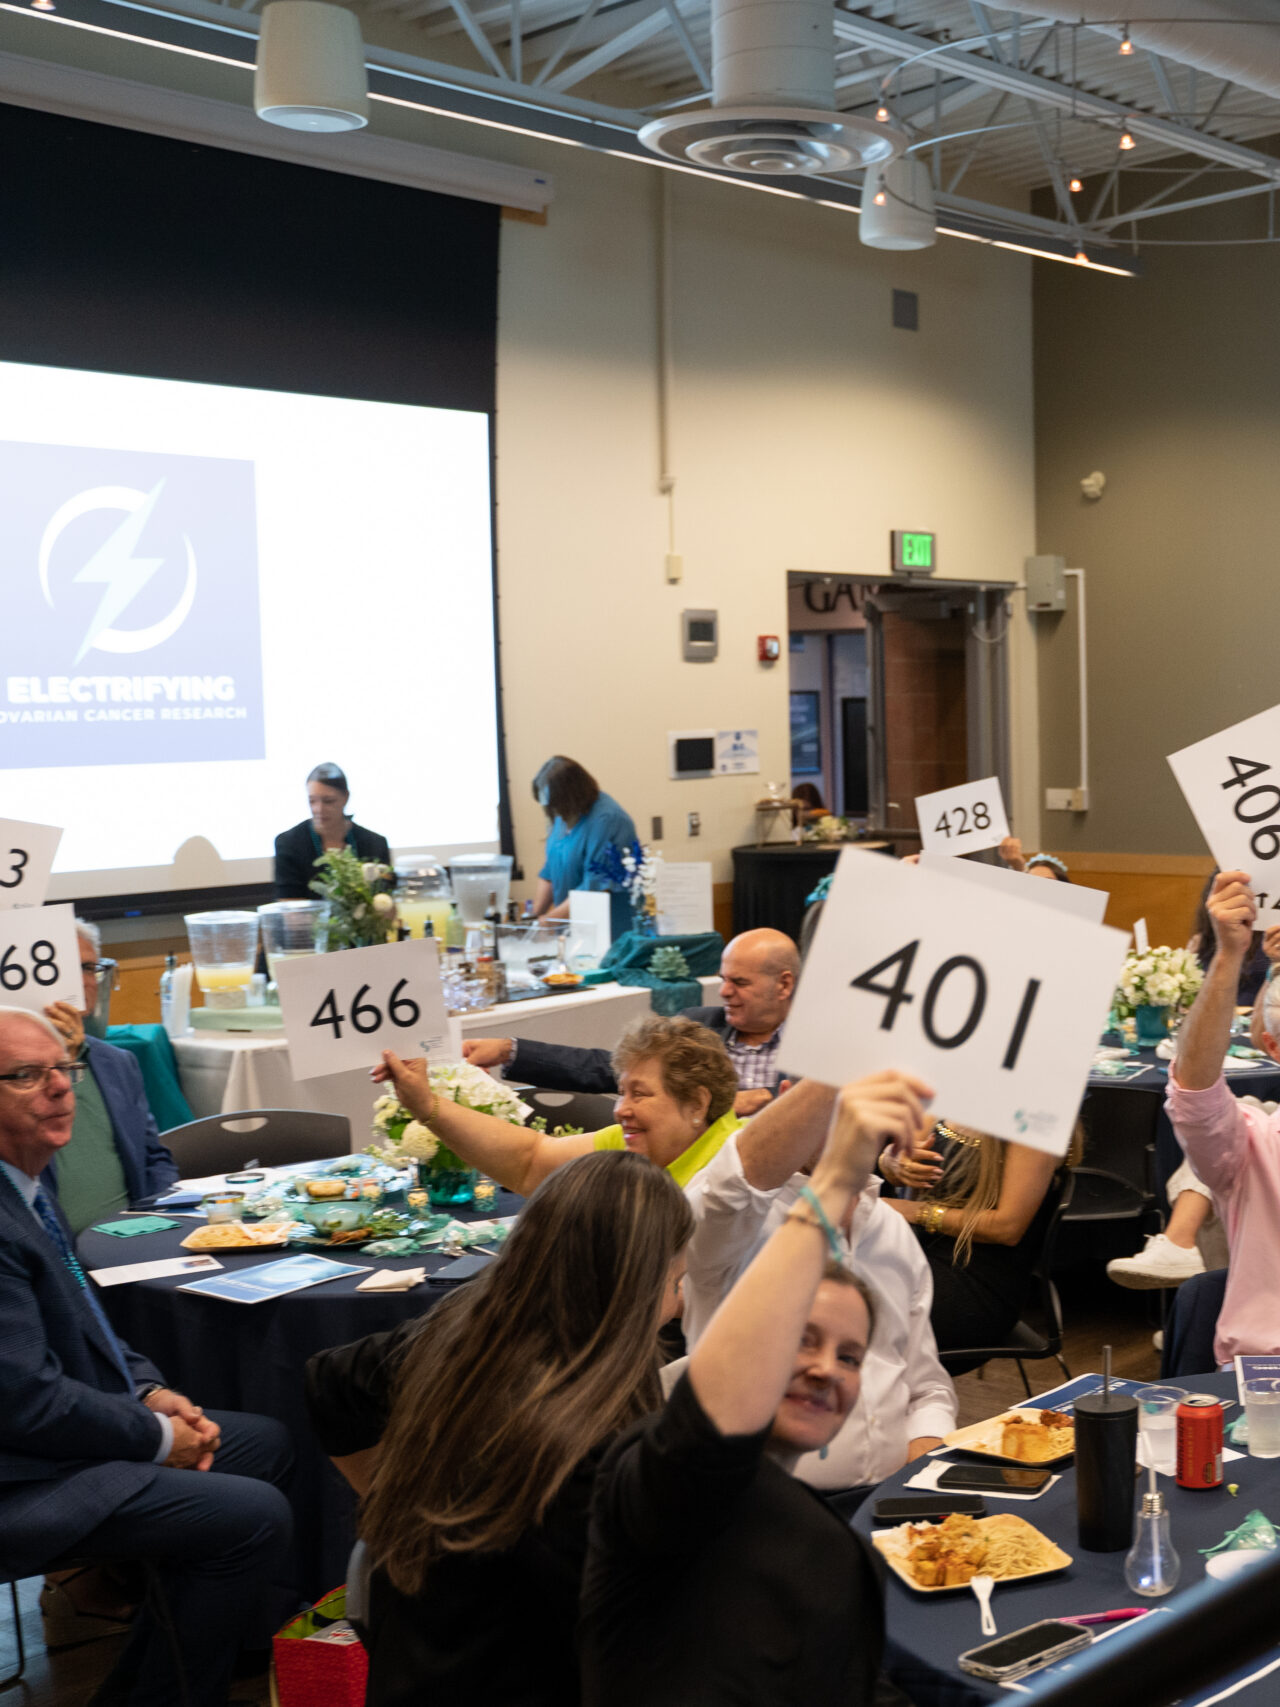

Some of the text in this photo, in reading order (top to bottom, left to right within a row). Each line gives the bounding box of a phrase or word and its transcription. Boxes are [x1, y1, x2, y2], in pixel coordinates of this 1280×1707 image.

[903, 533, 933, 567] EXIT
[7, 676, 236, 703] ELECTRIFYING
[0, 707, 247, 724] OVARIAN CANCER RESEARCH
[935, 801, 991, 838] 428
[310, 978, 421, 1039] 466
[849, 939, 1042, 1071] 401
